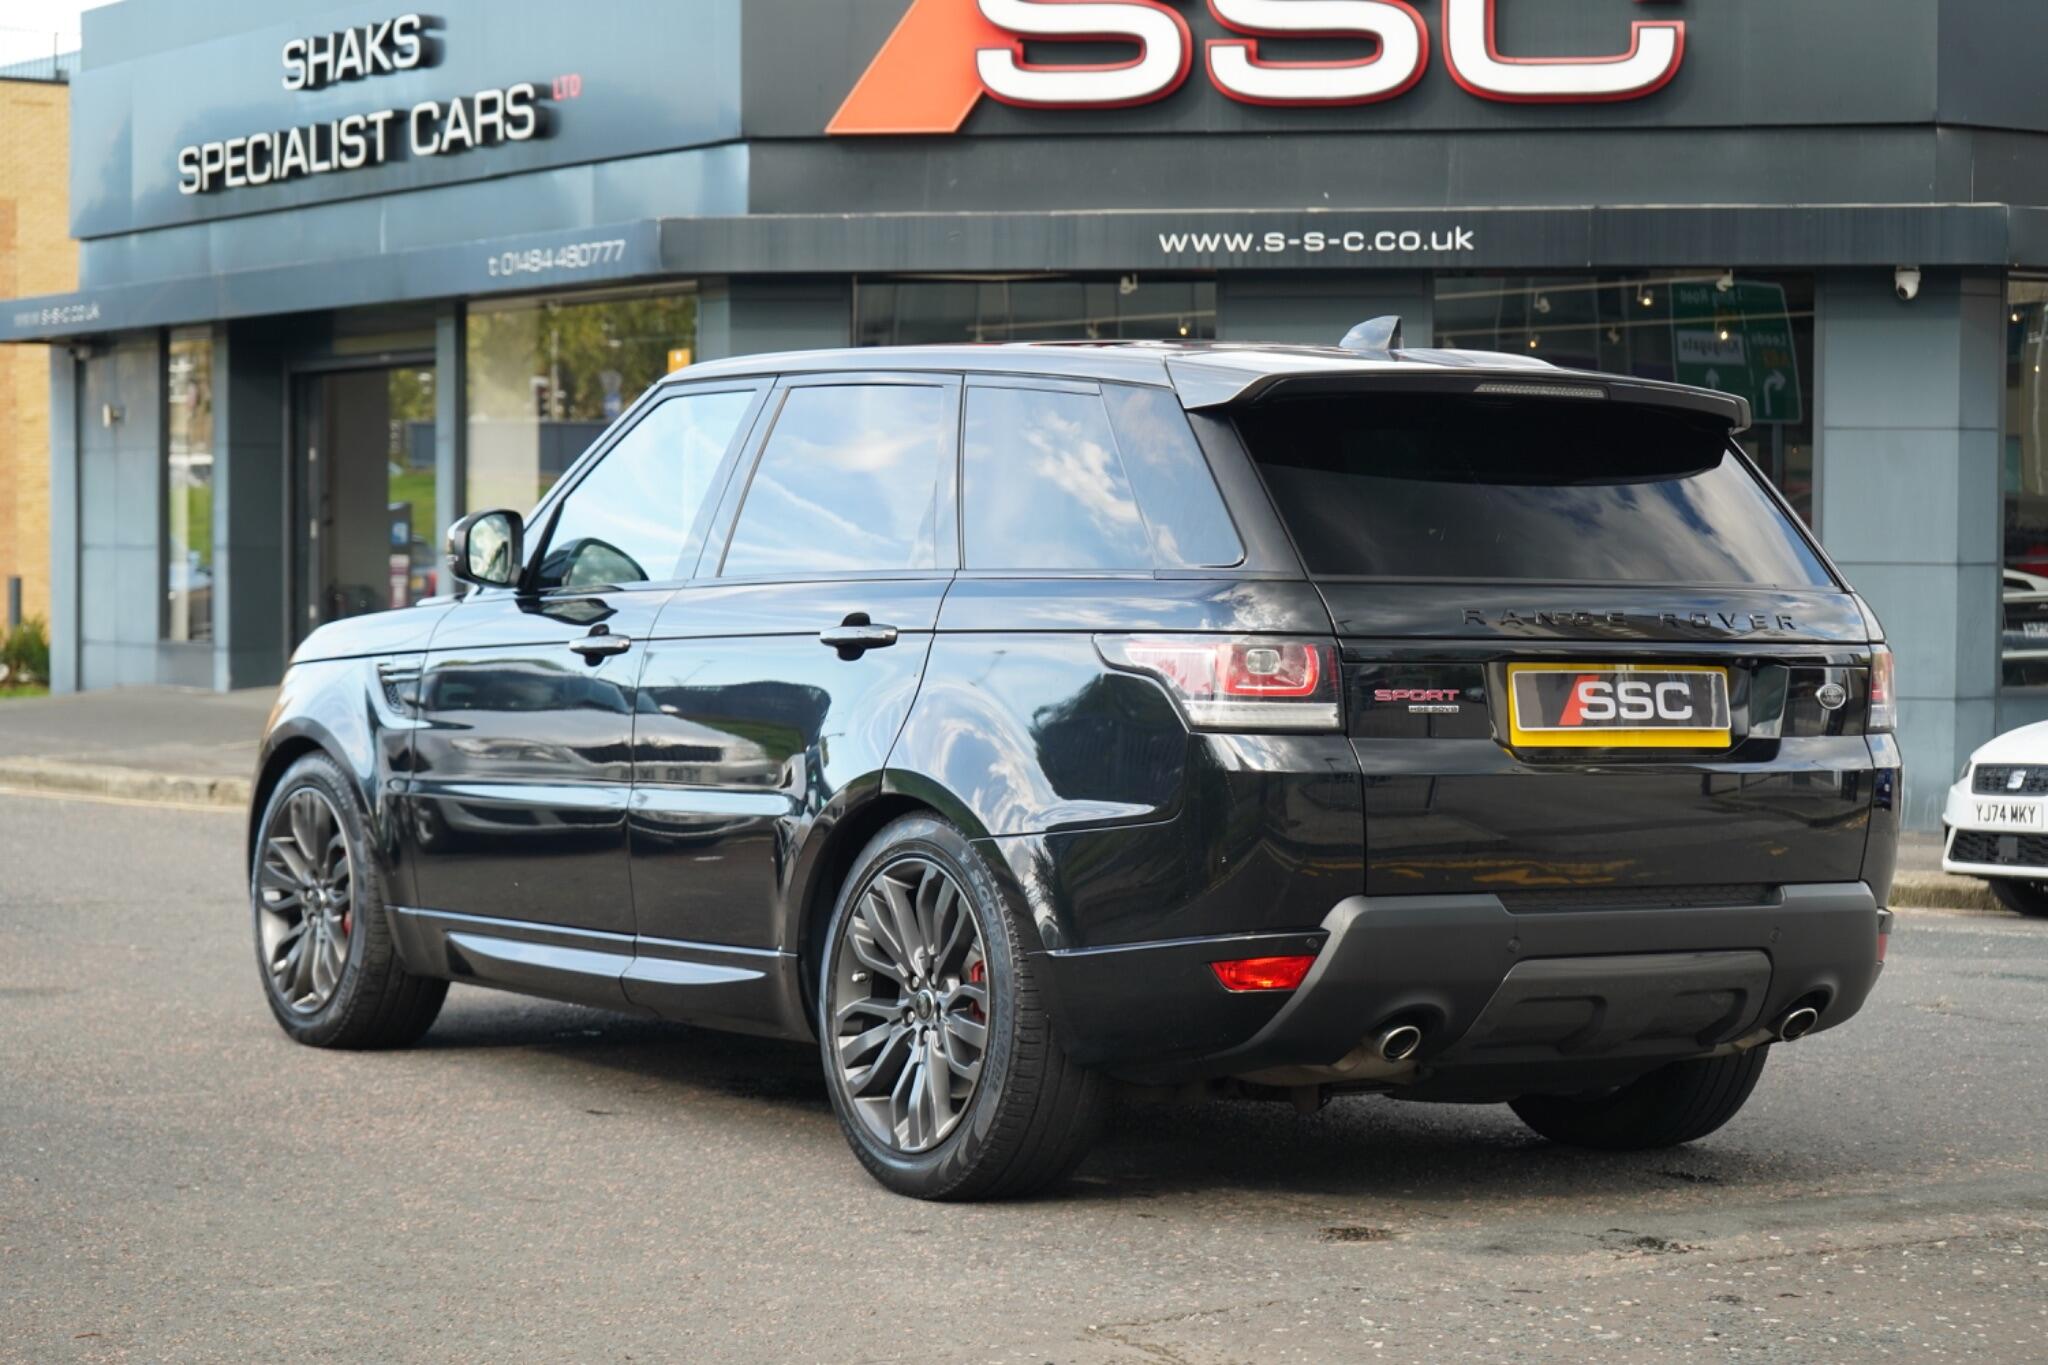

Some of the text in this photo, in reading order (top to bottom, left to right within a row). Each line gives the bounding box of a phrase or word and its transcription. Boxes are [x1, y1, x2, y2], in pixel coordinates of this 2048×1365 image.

[281, 13, 421, 91] SHAKS
[177, 72, 582, 195] SPECIALIST CARS LTD
[1158, 225, 1475, 252] www.s-s-c.co.uk
[1462, 607, 1797, 631] RANGE ROVER
[1374, 688, 1460, 702] SPORT
[1577, 681, 1693, 720] SSC
[1976, 803, 2036, 825] YJ74 MKY
